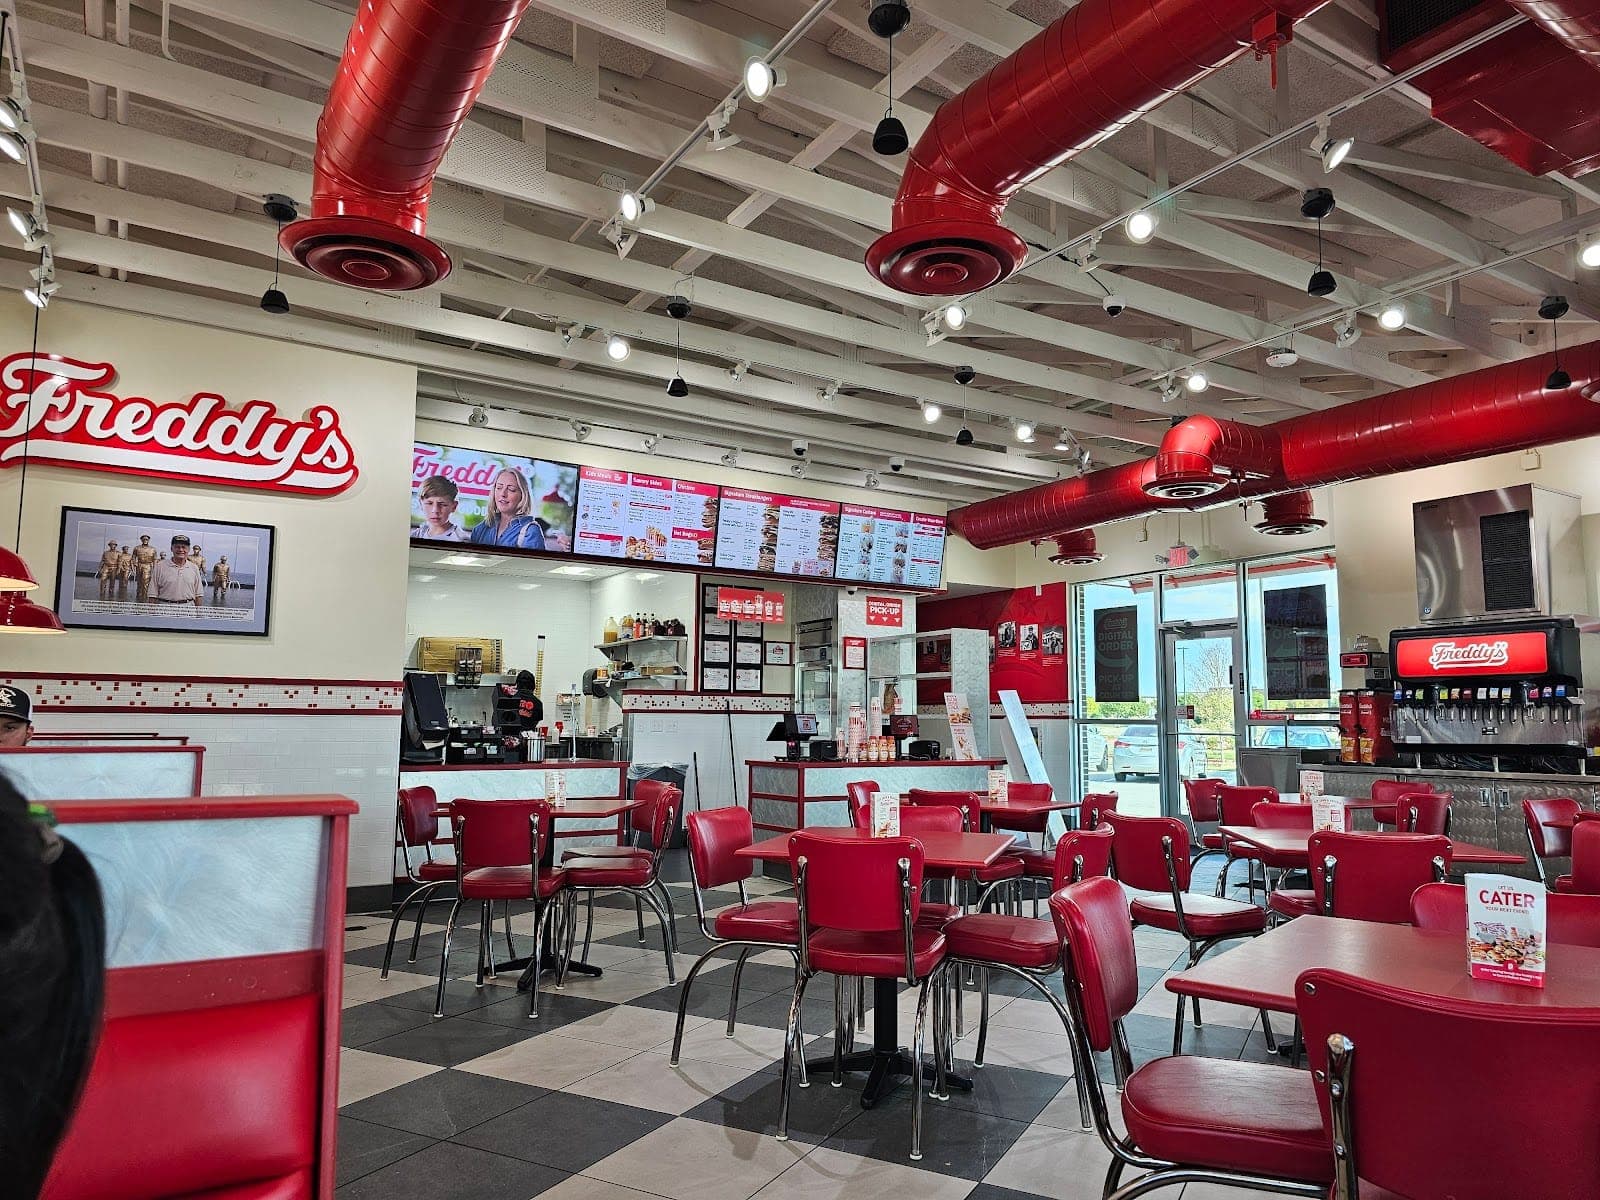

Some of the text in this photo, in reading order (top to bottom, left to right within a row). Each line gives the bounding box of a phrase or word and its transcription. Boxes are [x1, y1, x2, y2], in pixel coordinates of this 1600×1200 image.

[0, 355, 355, 489] Freddy's
[650, 479, 663, 487] Sides
[677, 482, 696, 491] Chicken
[674, 529, 682, 537] Hot
[870, 606, 899, 615] PICK-UP
[1098, 630, 1133, 641] DIGITAL
[1098, 640, 1134, 652] ORDER
[1430, 642, 1507, 669] Freddy's
[1098, 673, 1134, 684] PICK-UP
[1479, 889, 1535, 909] CATER
